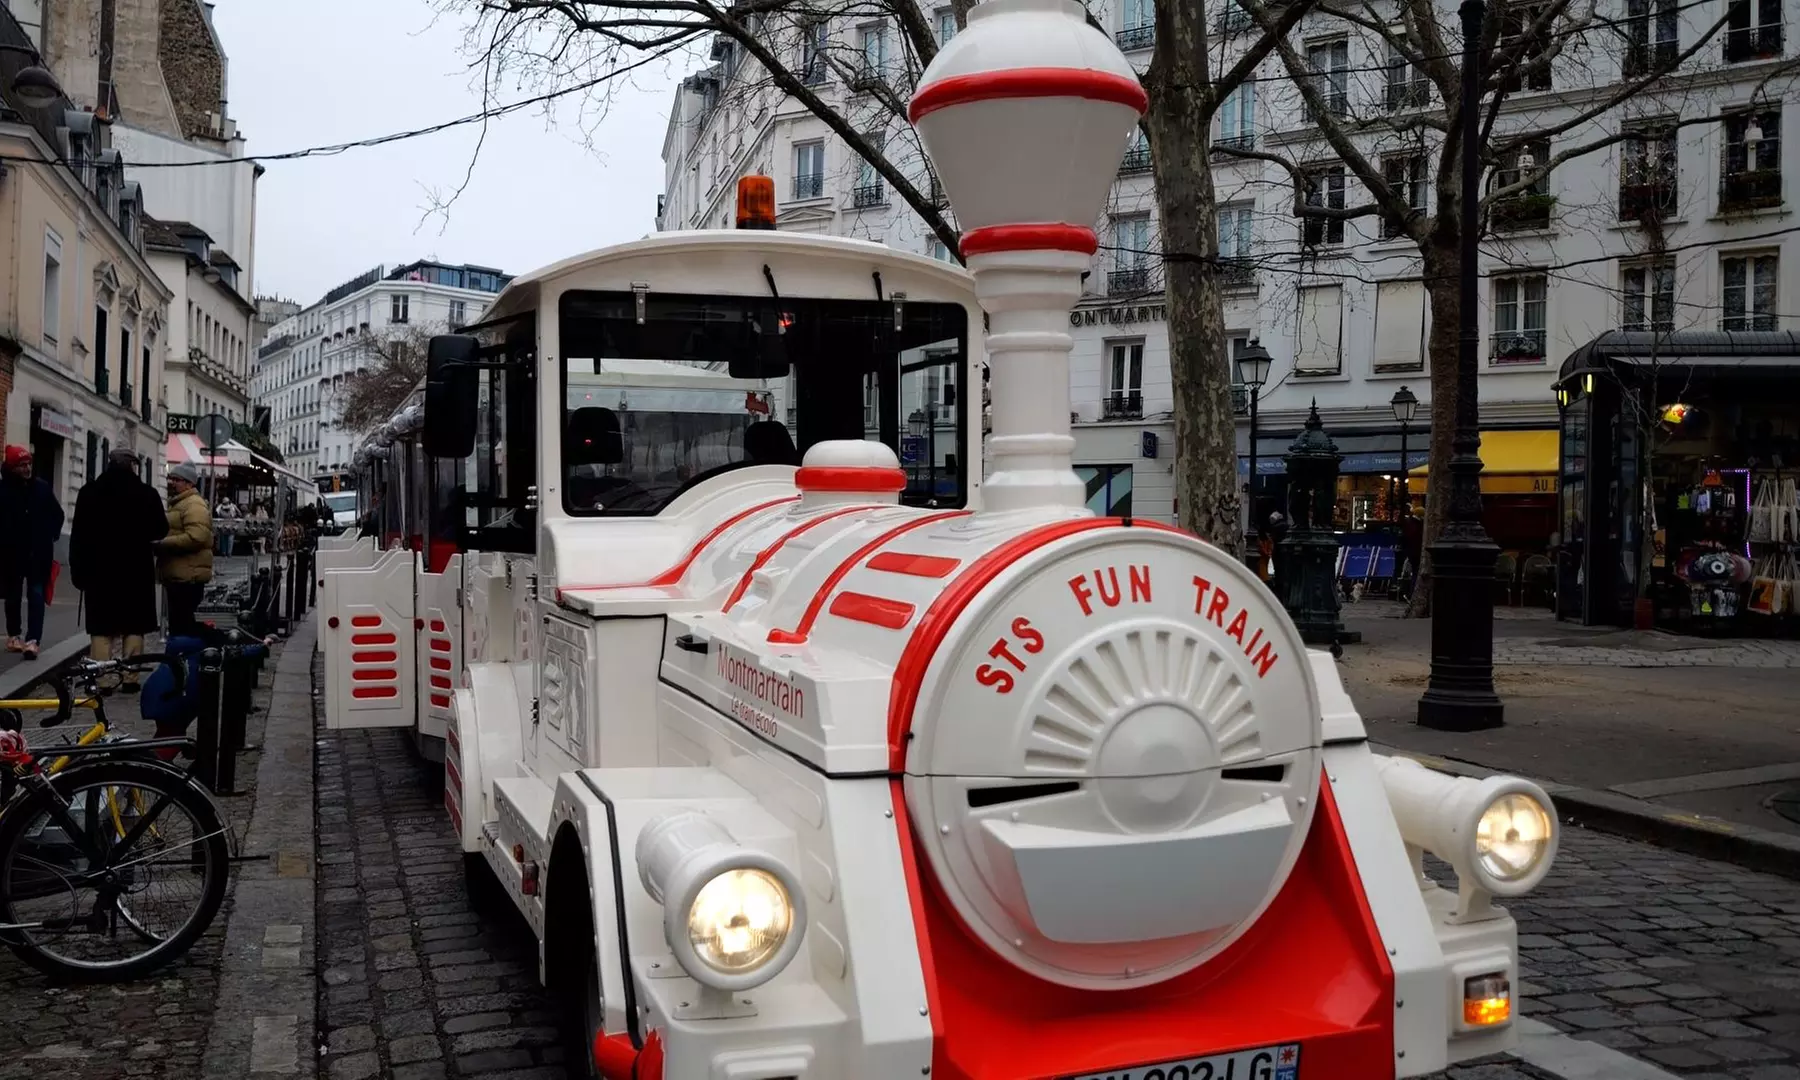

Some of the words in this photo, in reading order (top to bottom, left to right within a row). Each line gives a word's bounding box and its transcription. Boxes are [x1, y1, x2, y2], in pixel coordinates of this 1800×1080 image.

[975, 616, 1045, 694] STS
[1067, 564, 1152, 617] FUN
[1192, 575, 1279, 679] TRAIN
[717, 643, 804, 719] Montmartrain
